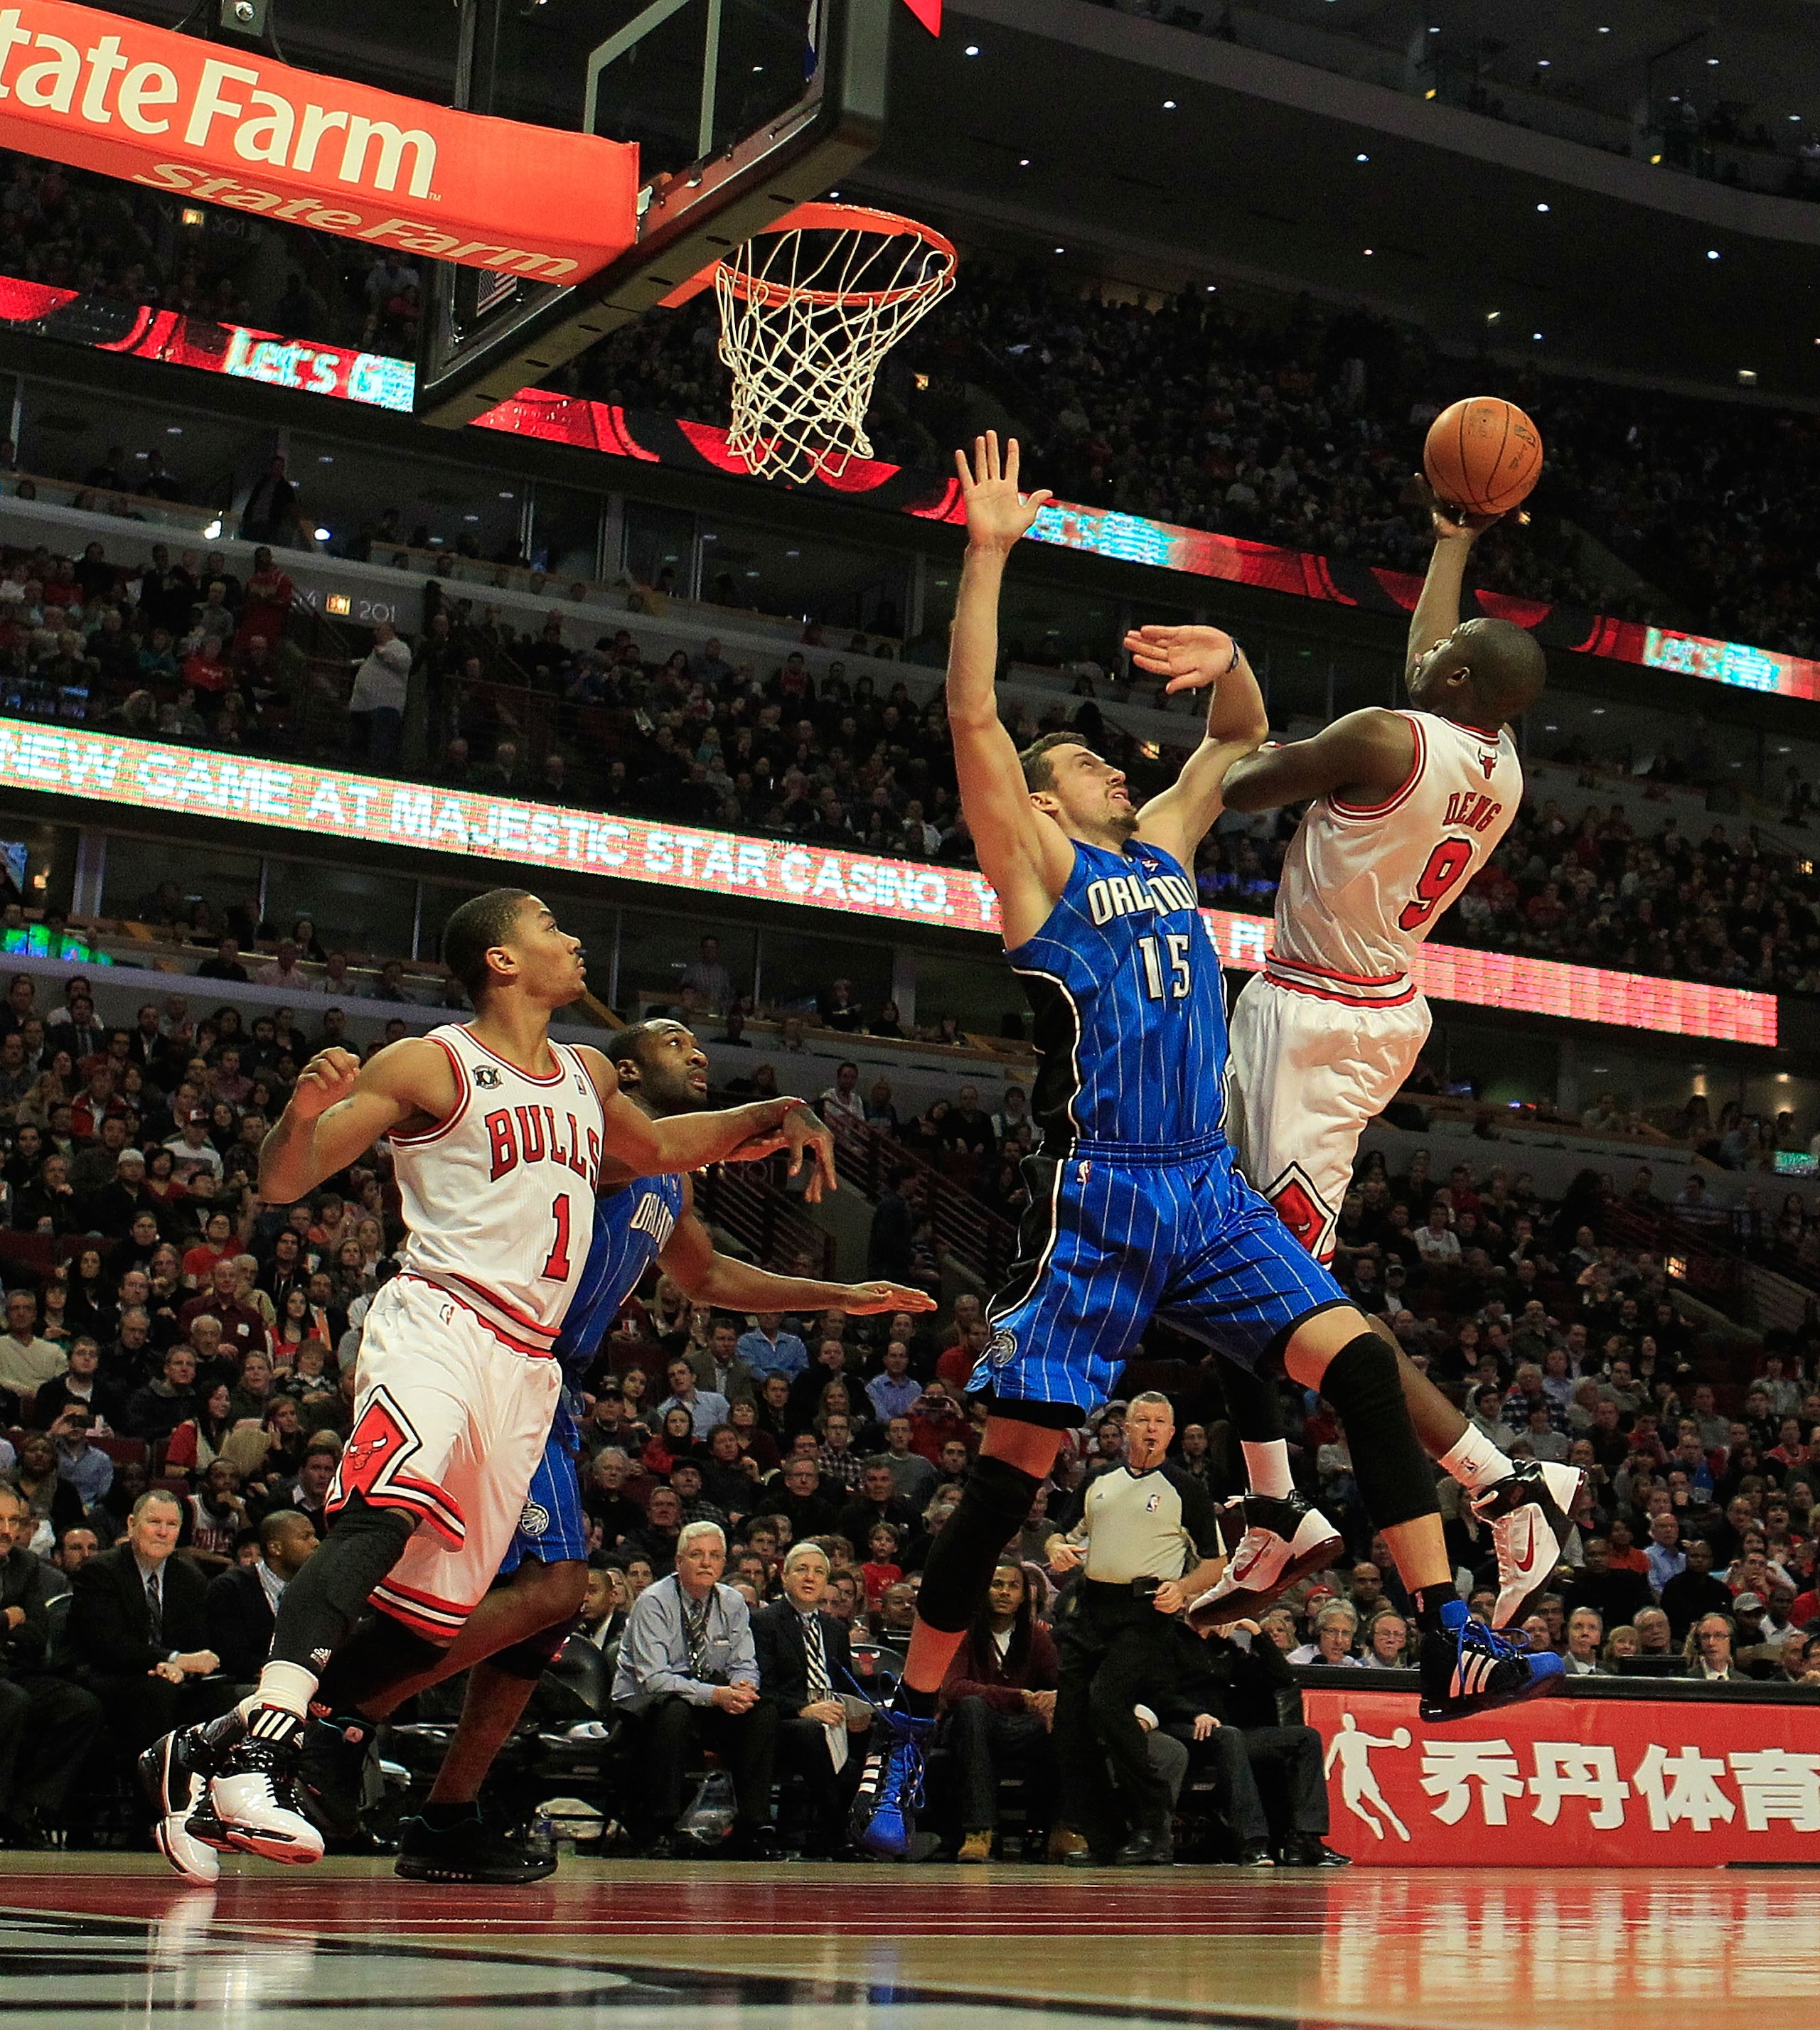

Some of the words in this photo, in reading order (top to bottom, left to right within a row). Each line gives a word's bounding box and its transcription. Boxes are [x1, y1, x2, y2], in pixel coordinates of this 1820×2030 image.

[0, 9, 179, 135] tate
[360, 601, 395, 623] 201
[0, 729, 124, 789] NEW
[137, 753, 293, 817] GAME
[306, 779, 378, 829] AT
[390, 789, 630, 866] MAJESTIC
[643, 830, 768, 888] STAR
[1442, 791, 1502, 832] DENG
[1398, 836, 1473, 932] 9
[1138, 933, 1192, 999] 15
[484, 1104, 600, 1194] BULLS
[541, 1193, 570, 1282] 1
[1420, 1738, 1820, 1833] 乔丹体育
